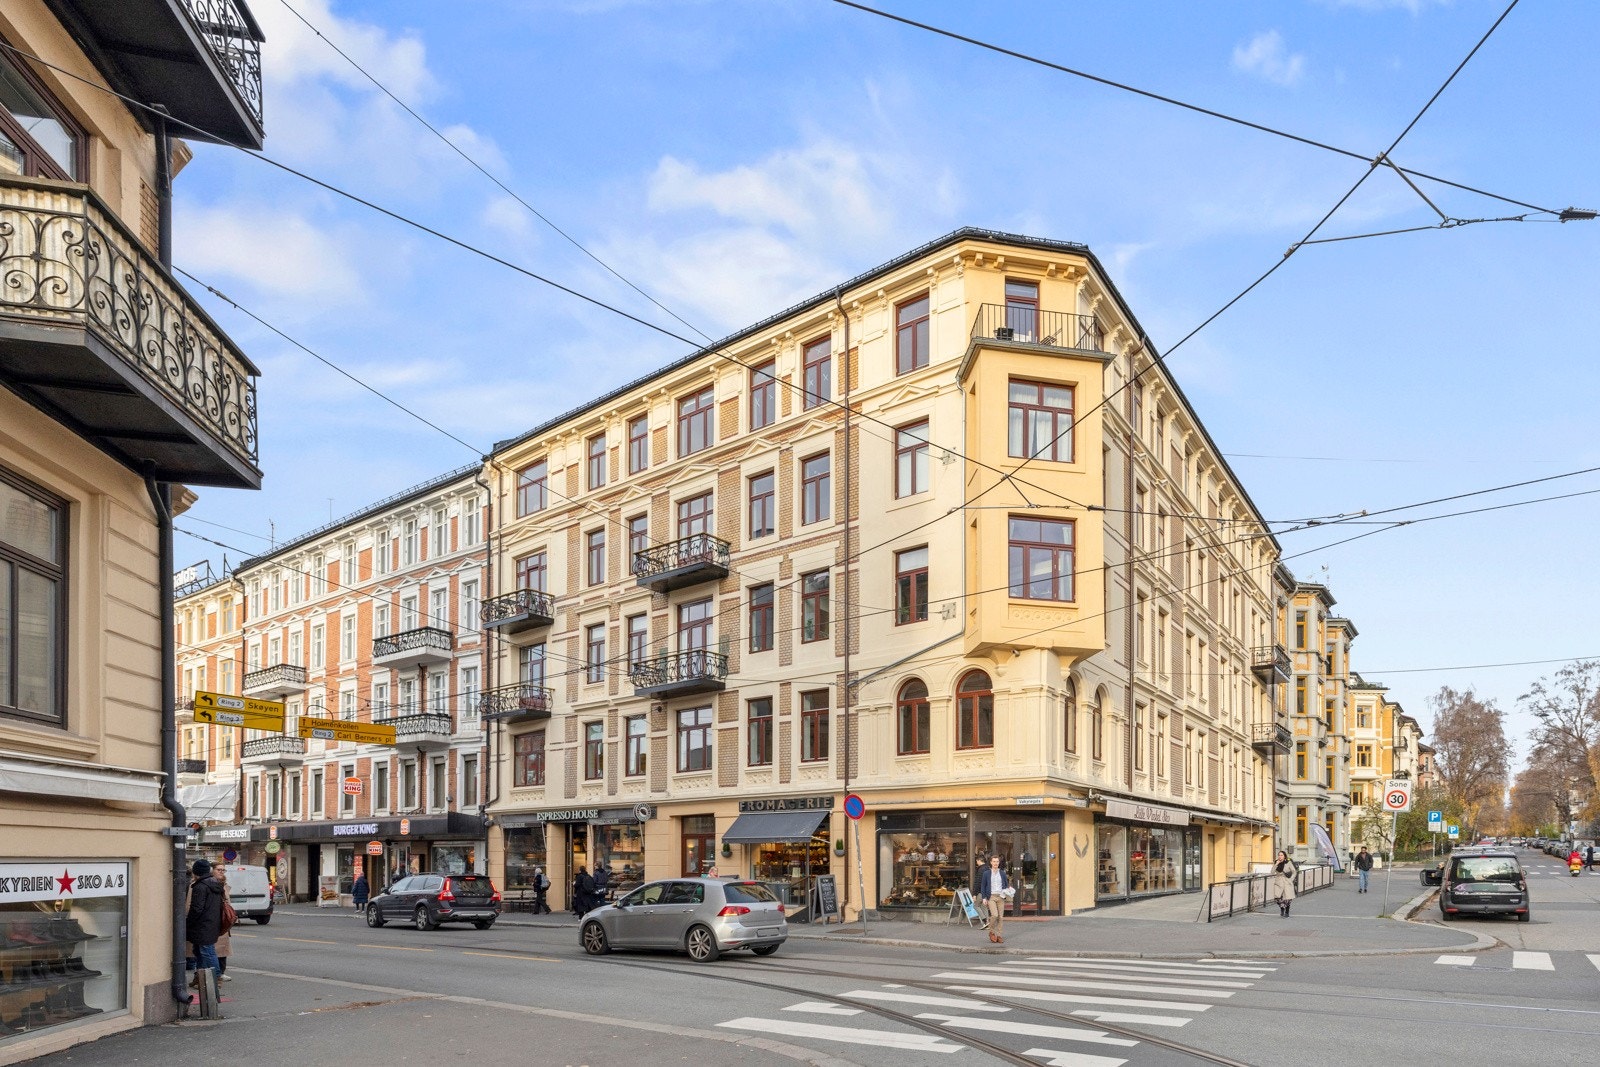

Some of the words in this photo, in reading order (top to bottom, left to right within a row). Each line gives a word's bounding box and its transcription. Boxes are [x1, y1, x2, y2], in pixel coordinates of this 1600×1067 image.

[221, 699, 235, 707] Ring
[248, 702, 279, 713] Skøyen
[220, 714, 234, 722] Ring
[311, 720, 359, 730] Holmenkollen
[355, 733, 382, 742] Berners
[740, 798, 832, 811] FROMAGERIE
[1390, 795, 1404, 804] 30
[536, 810, 571, 821] ESPRESSO
[571, 808, 599, 819] HOUSE
[333, 825, 359, 836] BURGER
[359, 823, 377, 835] KING
[77, 874, 102, 890] SKO
[104, 874, 125, 888] A/S
